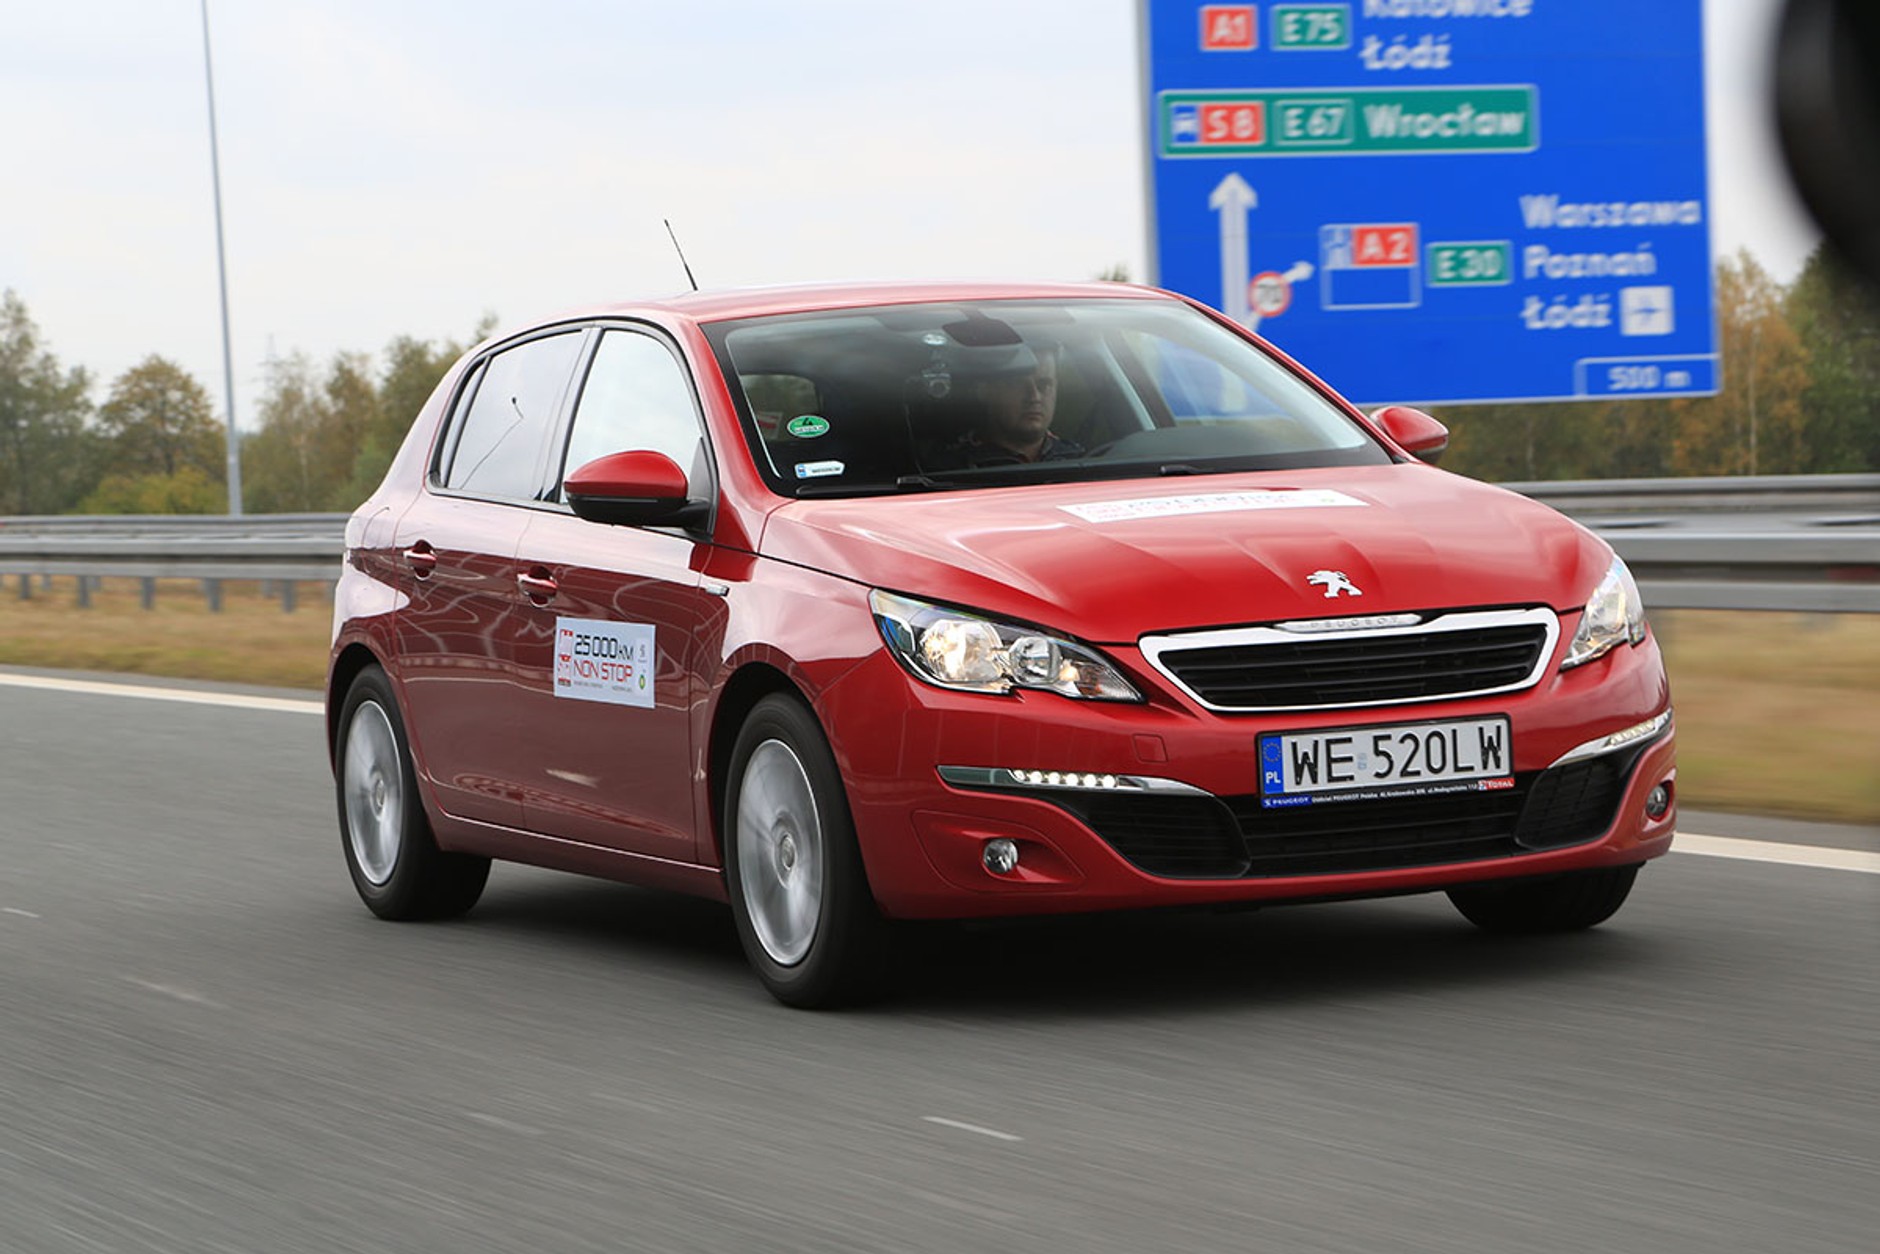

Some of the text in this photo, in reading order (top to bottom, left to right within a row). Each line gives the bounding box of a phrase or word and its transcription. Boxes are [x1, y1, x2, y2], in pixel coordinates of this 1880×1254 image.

[1209, 13, 1248, 43] A1
[1280, 12, 1343, 43] E75
[1358, 33, 1453, 70] Łódź
[1283, 105, 1347, 140] E67
[1363, 102, 1526, 139] Wrocław
[1518, 193, 1702, 229] Warszawa
[1361, 230, 1411, 261] A2
[1523, 241, 1658, 280] Poznań
[1435, 248, 1502, 280] E30
[1519, 293, 1613, 331] Łódź
[1607, 364, 1662, 391] 500
[601, 661, 634, 683] STOP
[1291, 724, 1503, 786] WE 520LW
[1265, 770, 1282, 784] PL
[1488, 780, 1515, 789] TOTAL
[1272, 796, 1309, 805] PEUGEOT
